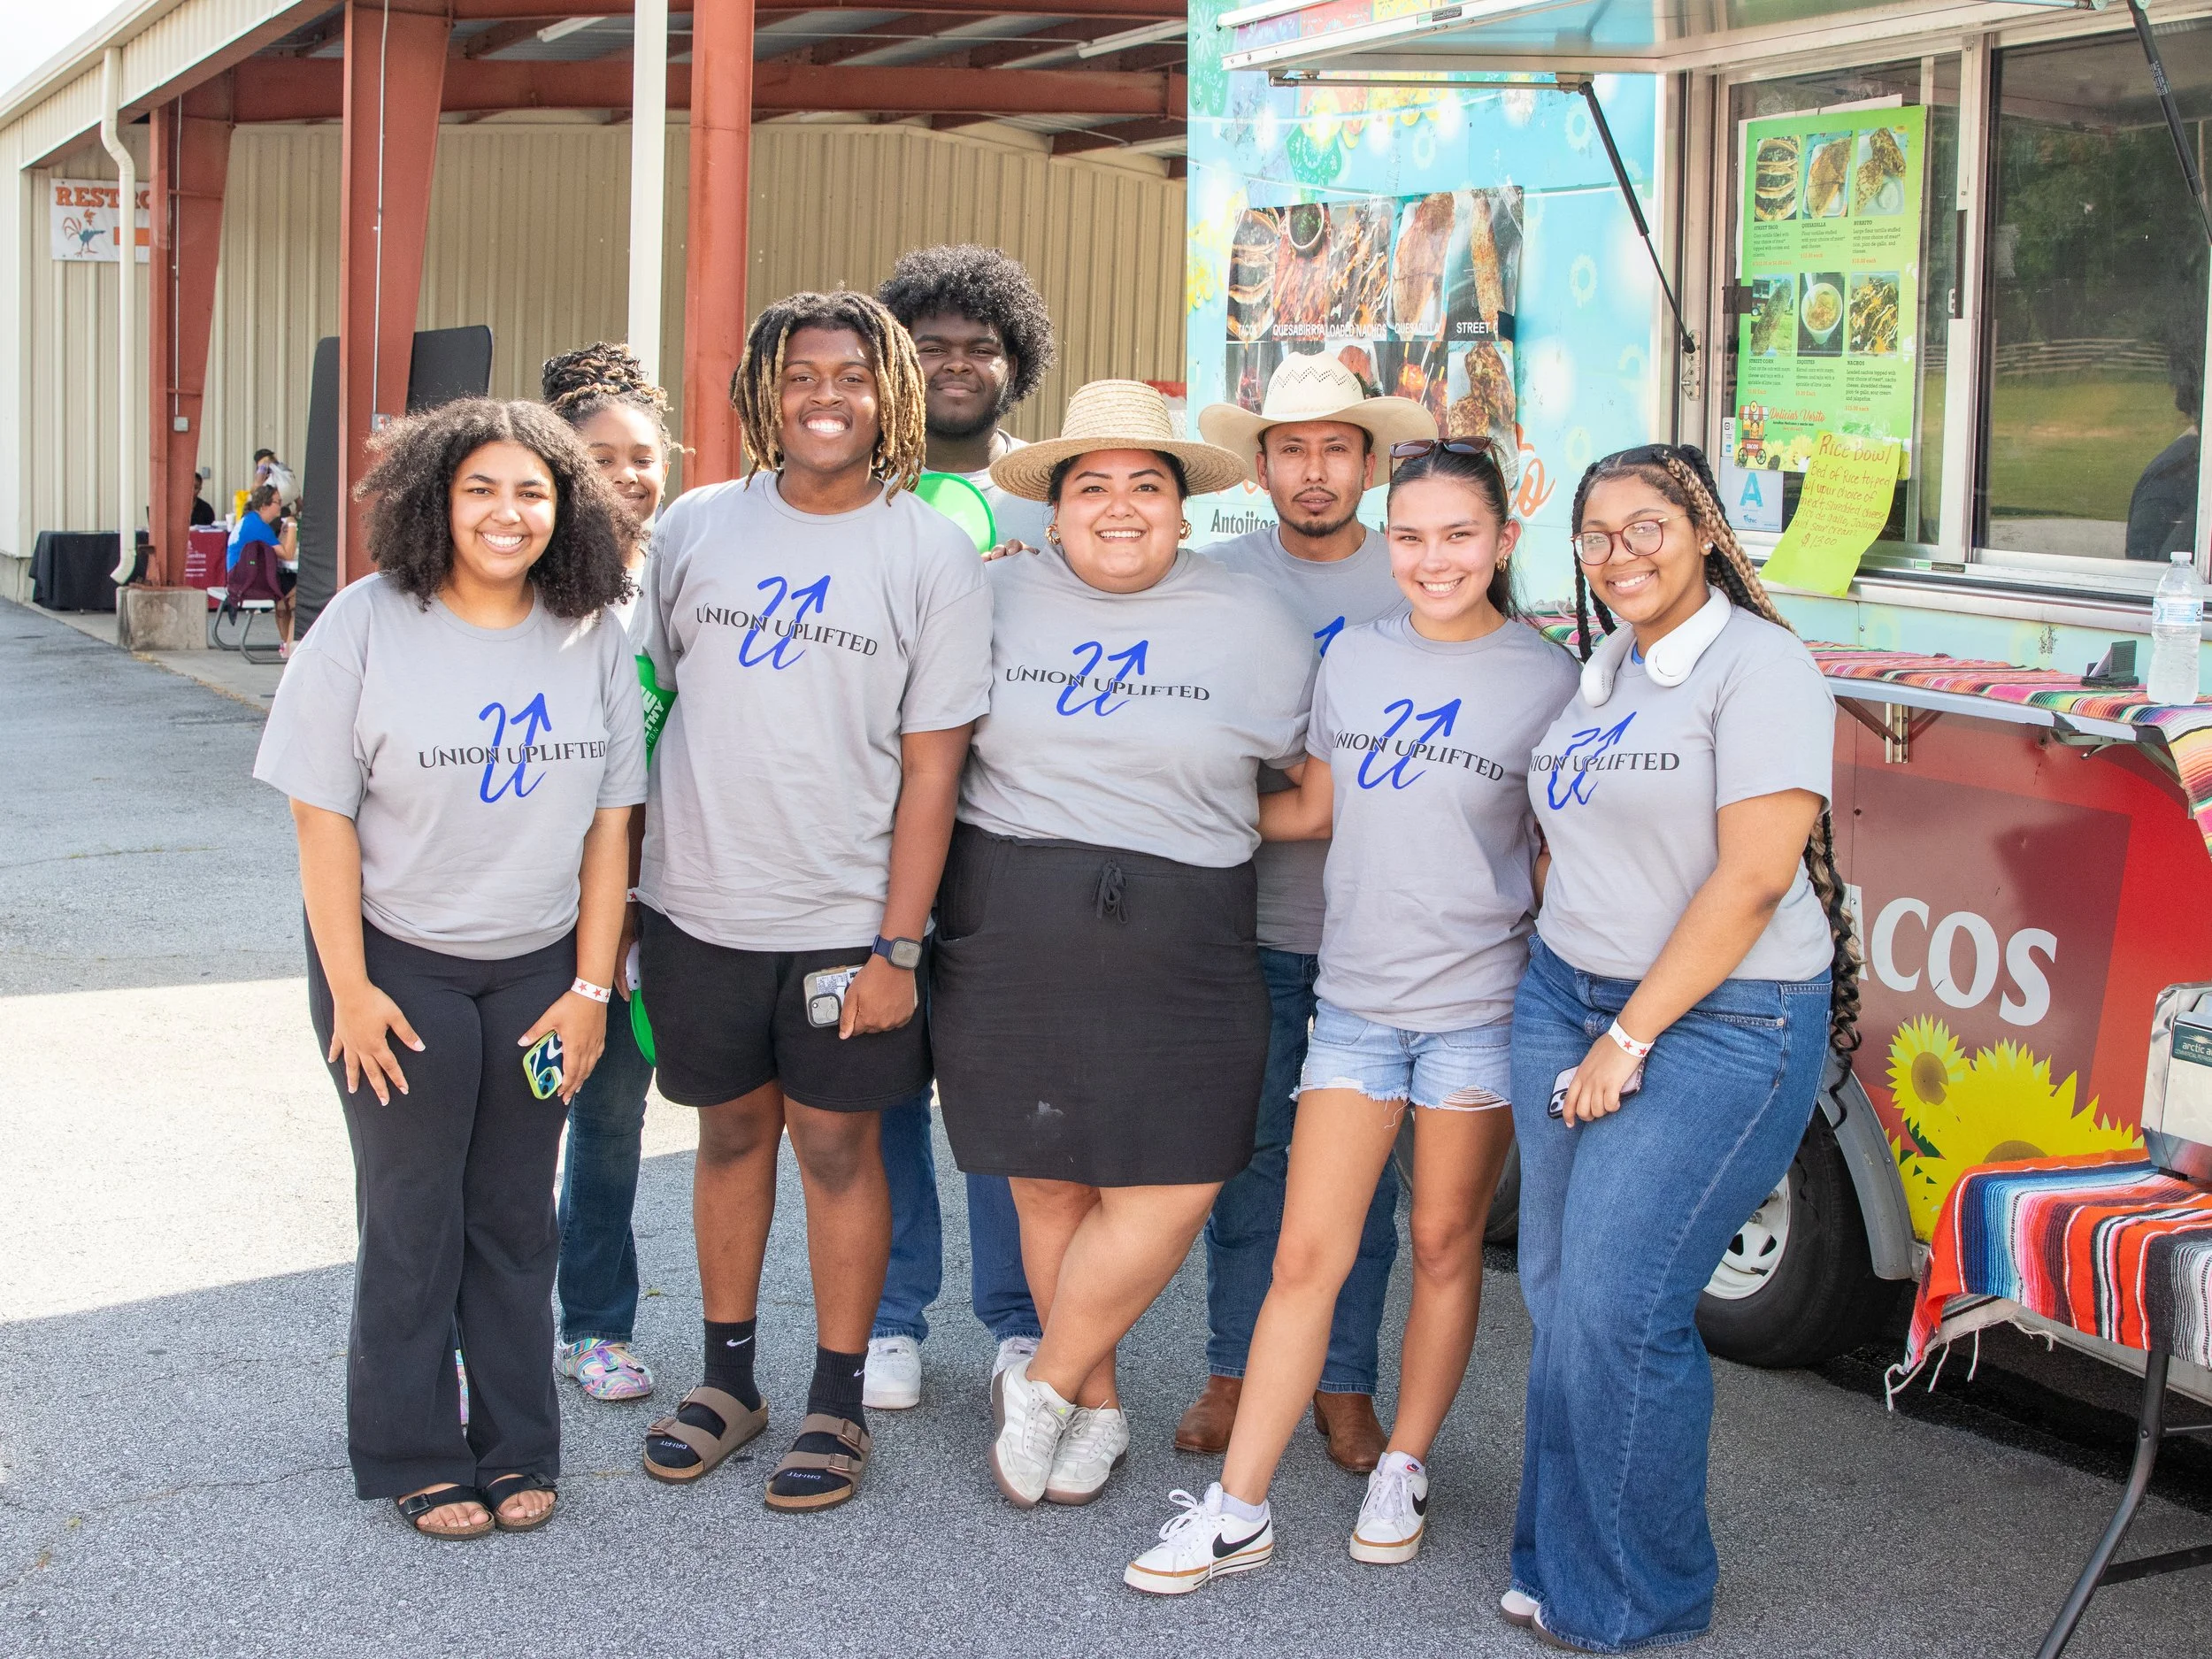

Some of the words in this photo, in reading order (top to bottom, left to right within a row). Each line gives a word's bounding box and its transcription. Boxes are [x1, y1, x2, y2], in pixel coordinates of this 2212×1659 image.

[1455, 321, 1490, 334] STREET
[1818, 434, 1850, 458] Rice
[1810, 460, 1828, 479] Bed
[1829, 465, 1843, 481] of
[1740, 472, 1763, 508] A
[1816, 484, 1837, 503] your
[1863, 490, 1878, 503] of
[696, 603, 769, 633] UNION
[774, 618, 878, 657] UPLIFTED
[1006, 664, 1086, 688] UNION
[1094, 677, 1210, 701] UPLIFTED
[419, 745, 500, 769] UNION
[507, 741, 606, 764] UPLIFTED
[1394, 739, 1504, 781] UPLIFTED
[1530, 754, 1568, 772] ION
[1573, 752, 1680, 772] UPLIFTED
[1845, 883, 2058, 1026] COS
[2182, 1041, 2205, 1054] arctic
[659, 1440, 687, 1450] DRI-FIT
[786, 1471, 822, 1480] DRI-FIT
